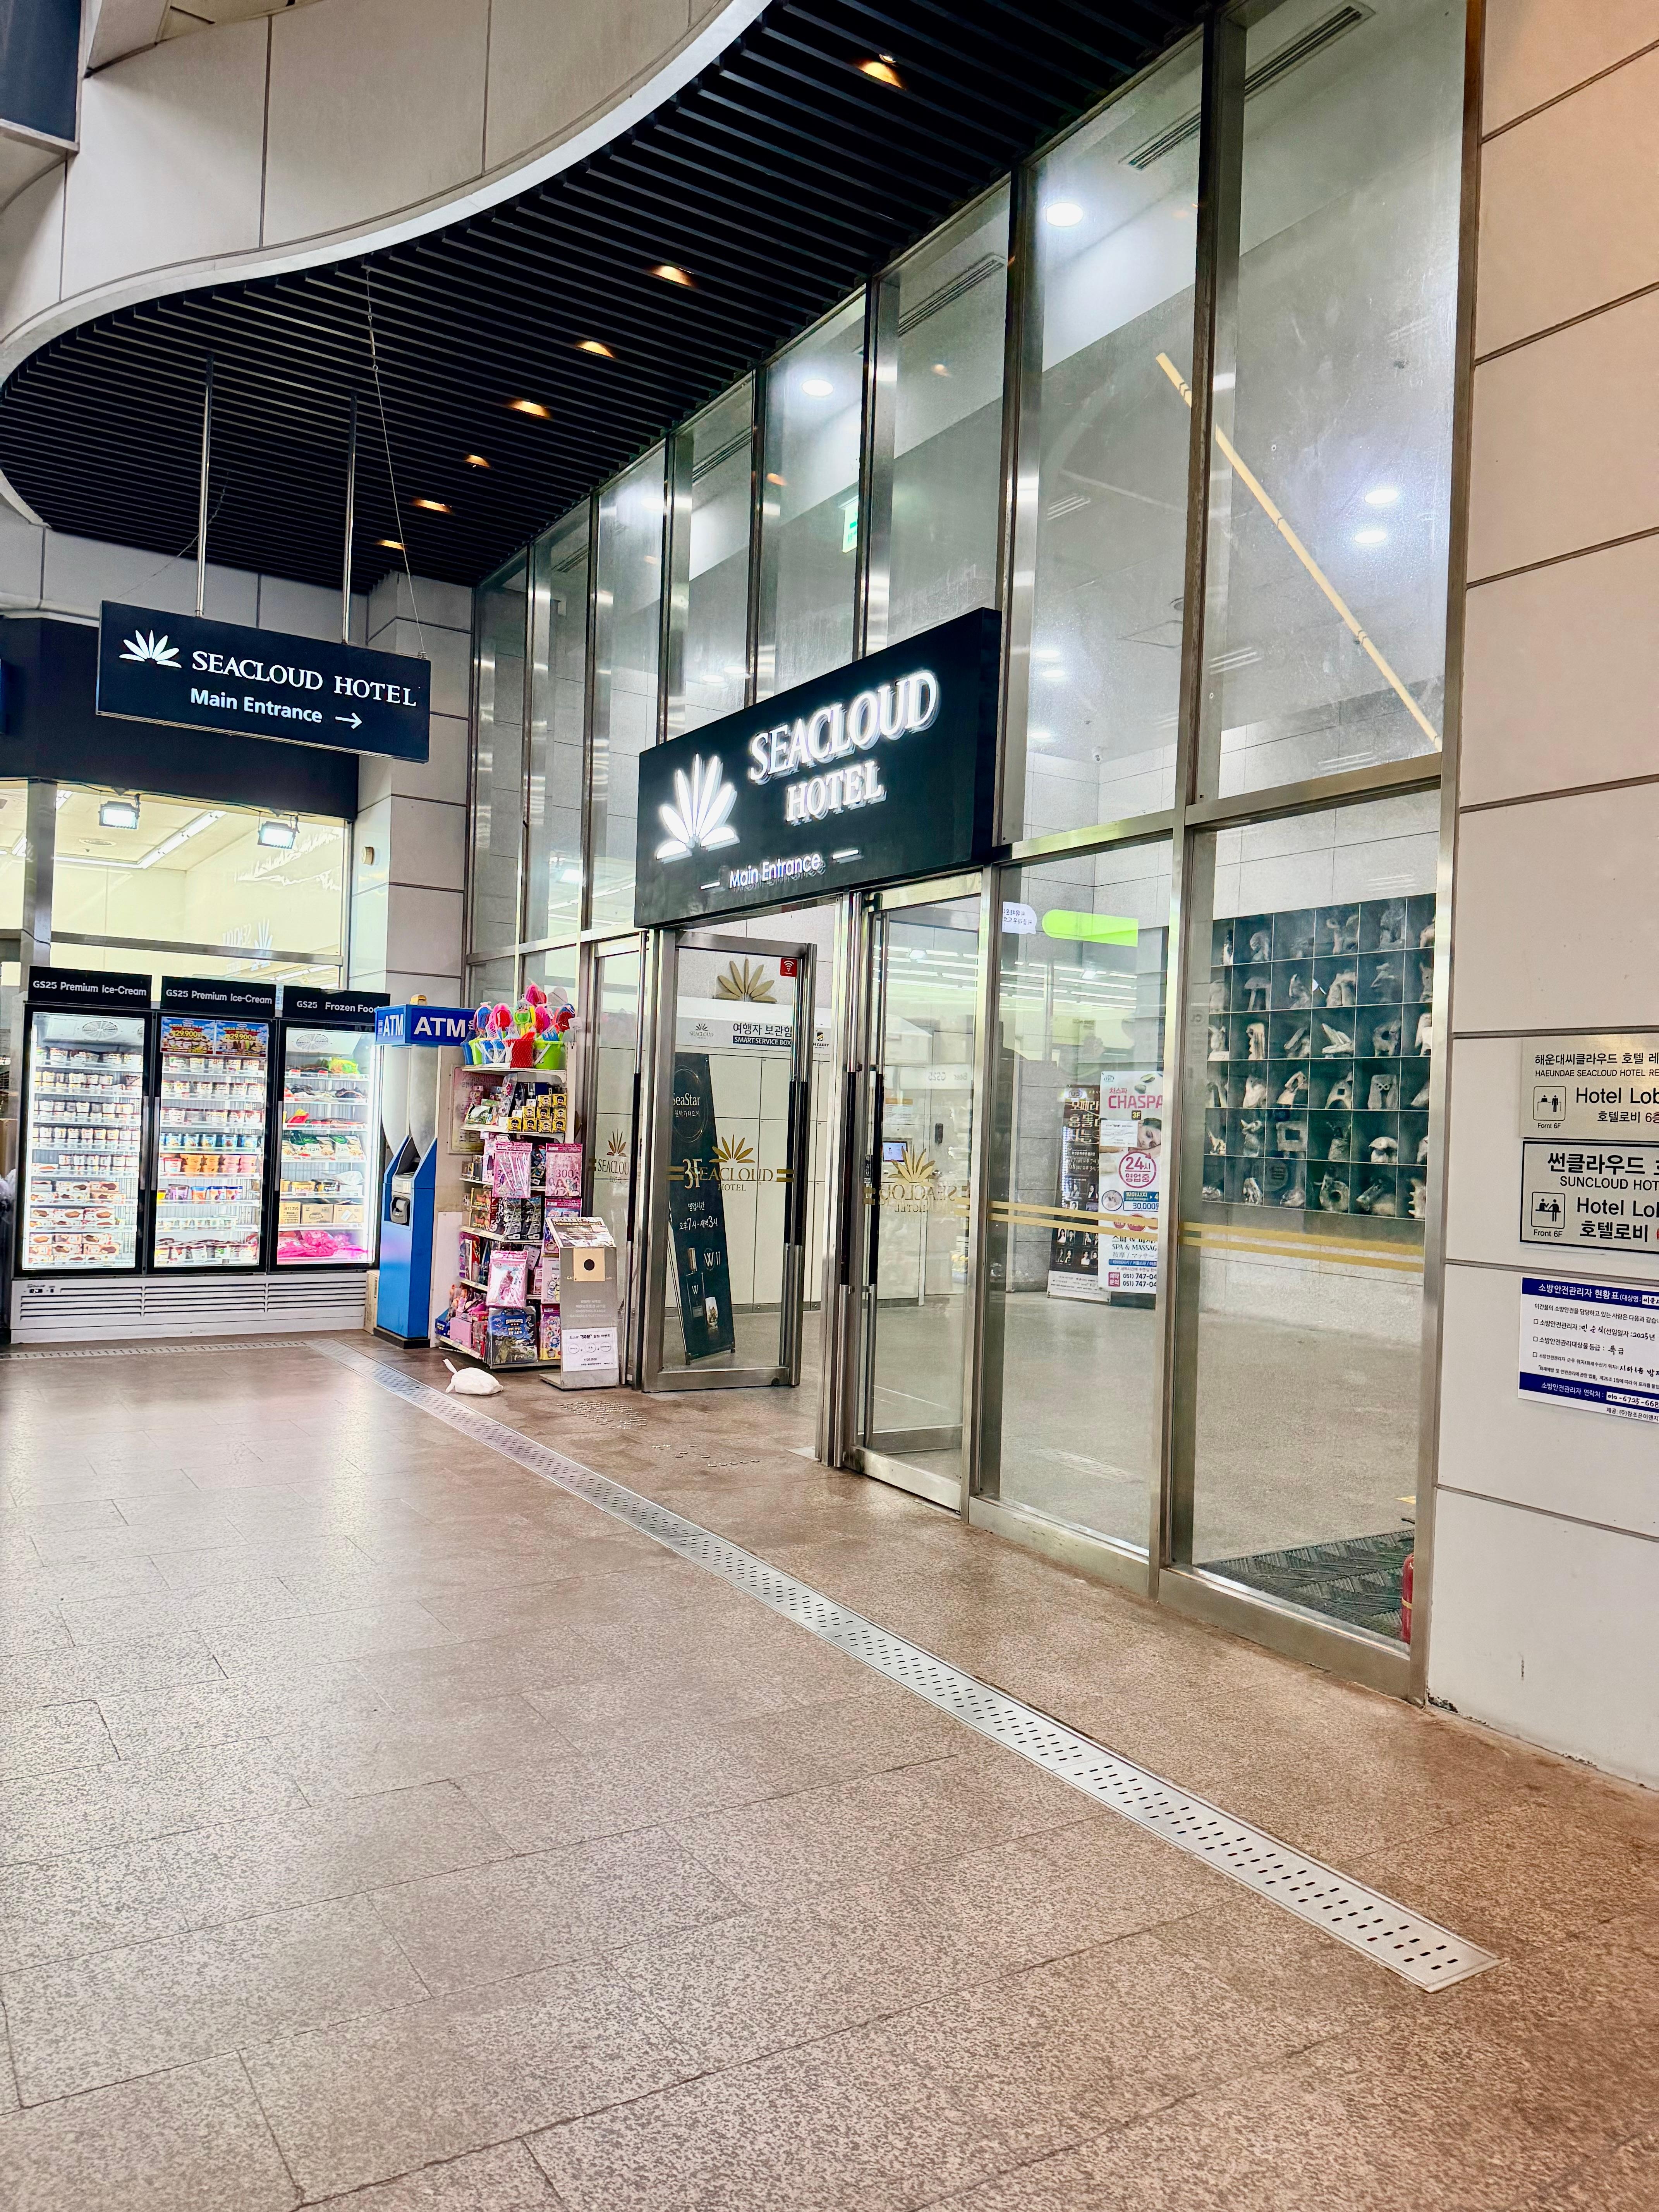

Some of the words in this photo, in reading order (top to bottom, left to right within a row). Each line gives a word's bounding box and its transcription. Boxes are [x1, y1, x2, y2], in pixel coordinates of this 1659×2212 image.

[192, 651, 323, 690] SEACLOUD
[334, 676, 416, 707] HOTEL
[191, 688, 237, 710] Main
[244, 696, 323, 723] Entrance
[750, 671, 937, 781] SEACLOUD
[786, 761, 883, 822] HOTEL
[729, 866, 759, 889] Main
[762, 854, 821, 883] Entrance
[33, 981, 57, 990] GS25
[60, 982, 98, 993] Premium
[101, 984, 147, 996] Ice-Cream
[166, 989, 189, 998] GS25
[191, 989, 227, 1001] Premium
[230, 993, 272, 1004] Ice-Cream
[325, 1002, 356, 1012] Frozen
[383, 1013, 404, 1037] ATM
[414, 1017, 465, 1037] ATM
[733, 1022, 762, 1035] 여행자
[1535, 1053, 1618, 1065] 해운대씨클라우드
[1622, 1053, 1644, 1064] 호텔
[1108, 1095, 1163, 1109] CHASPA
[1576, 1087, 1621, 1104] Hotel
[1597, 1111, 1640, 1123] 호텔로비
[598, 1159, 629, 1175] SEACLOU
[1547, 1152, 1645, 1175] 썬클라우드
[556, 1169, 574, 1178] 300
[682, 1158, 702, 1189] 3F
[689, 1167, 773, 1181] SEACLOUD
[1125, 1173, 1149, 1182] 영업중
[1560, 1176, 1628, 1189] SUNCLOUD
[688, 1201, 705, 1212] 영업시간
[1577, 1197, 1624, 1216] Hotel
[1580, 1220, 1648, 1242] 호텔로비
[1538, 1283, 1592, 1298] 소방안전관리자
[1539, 1320, 1577, 1331] 소방안전관리자
[1541, 1382, 1581, 1395] 소방안전관리자
